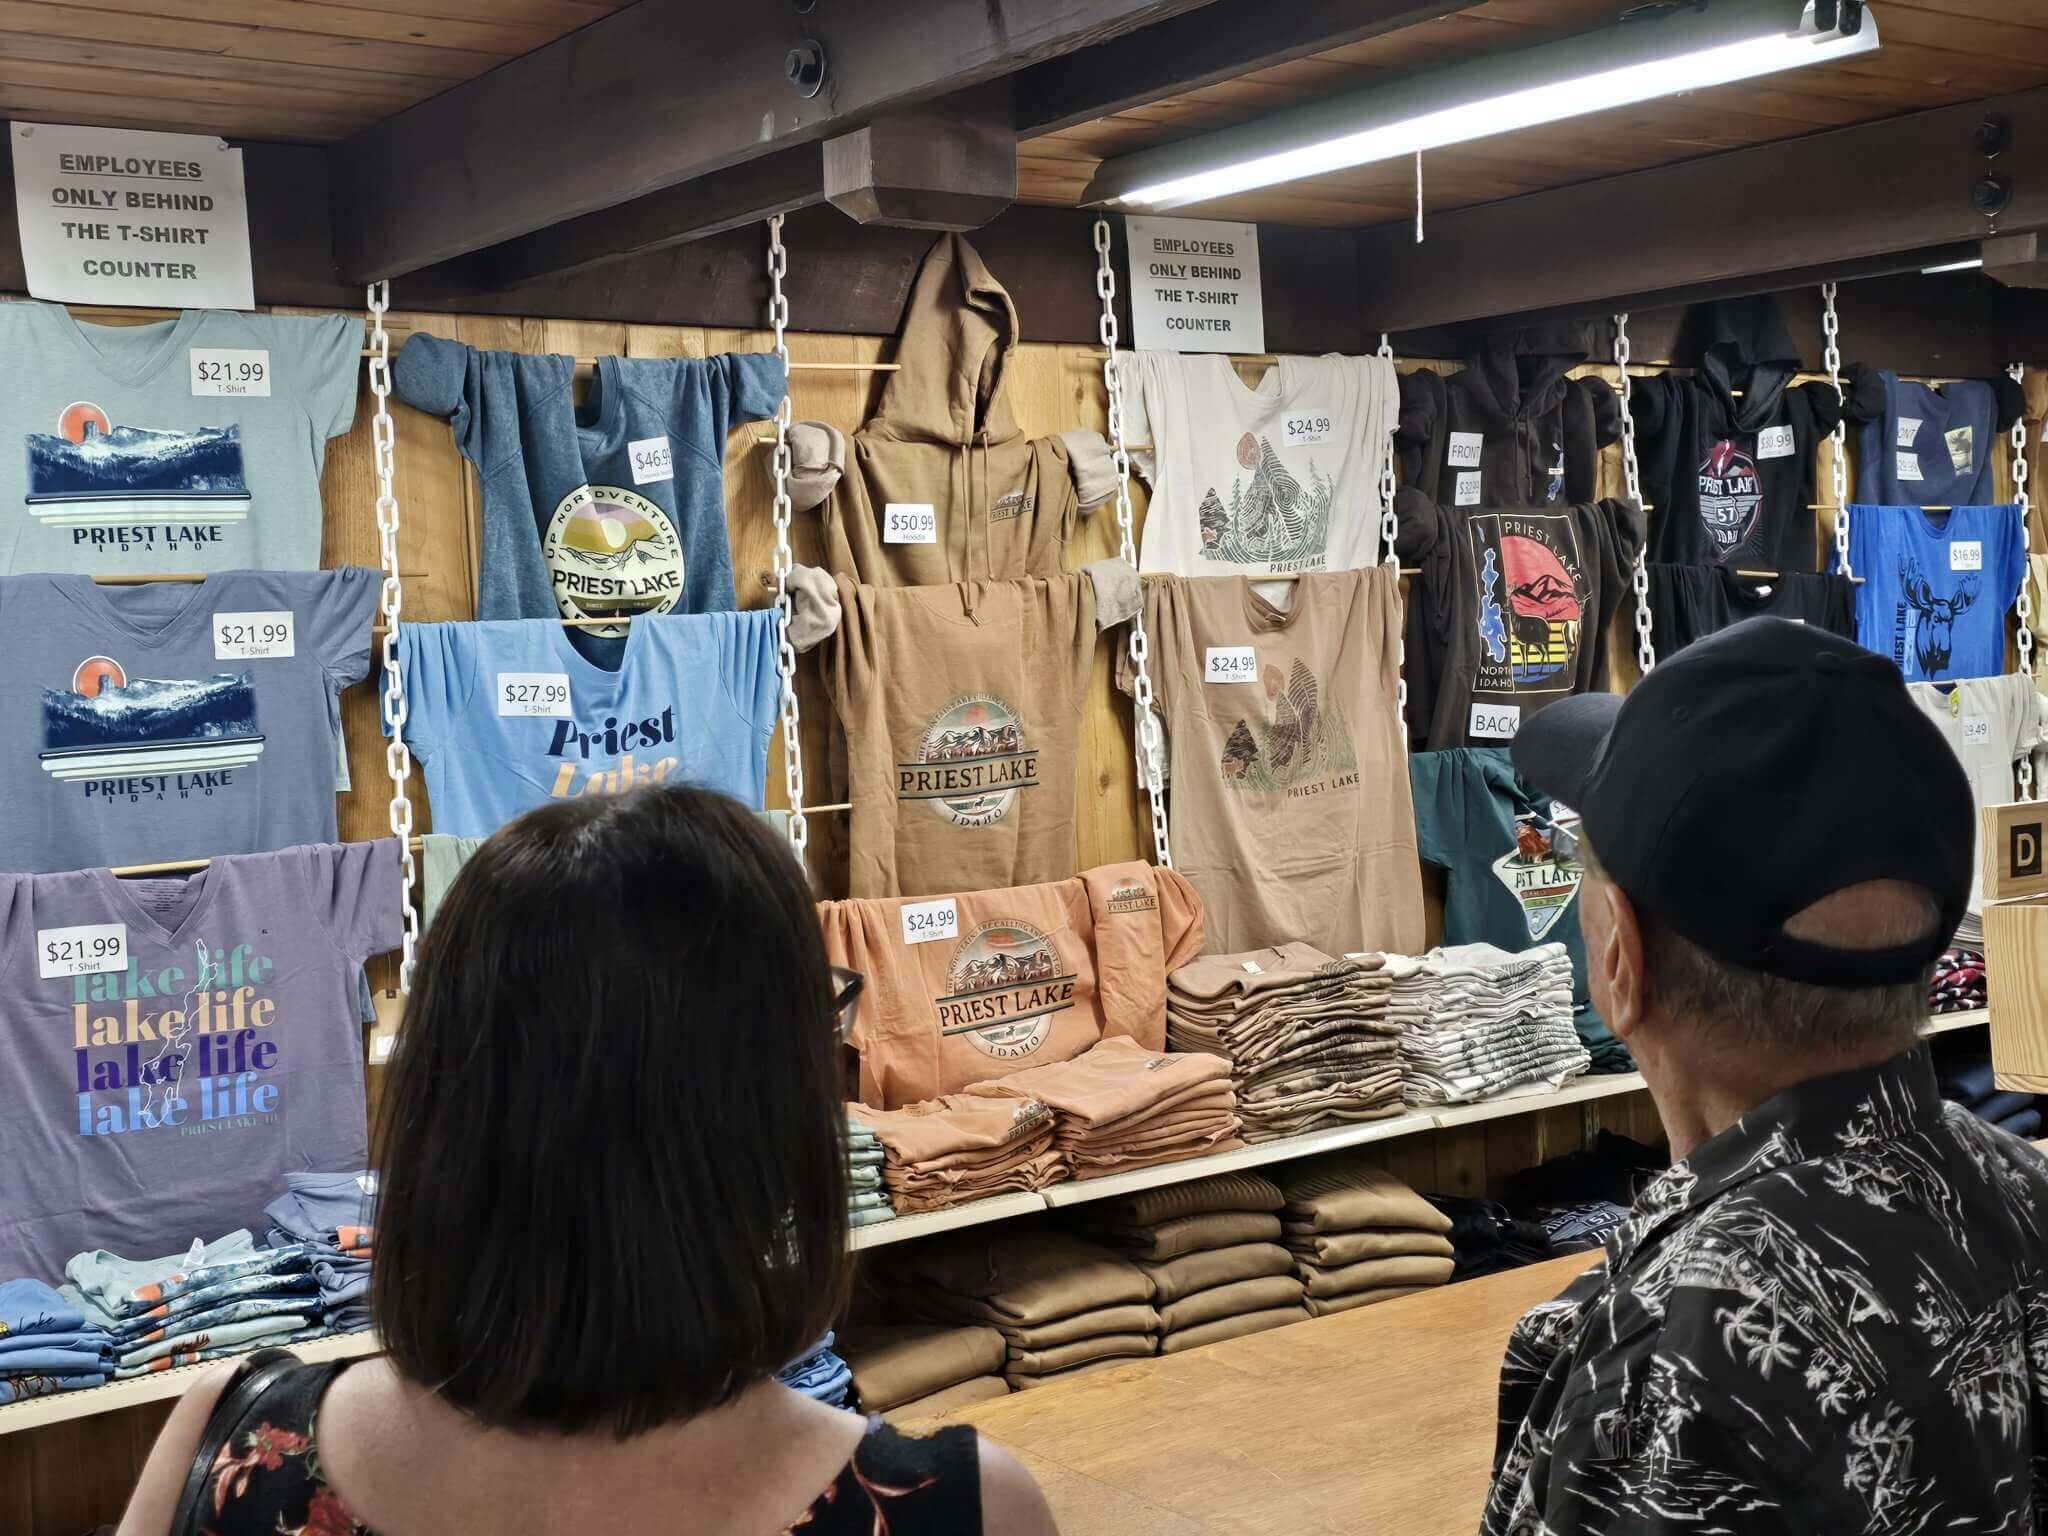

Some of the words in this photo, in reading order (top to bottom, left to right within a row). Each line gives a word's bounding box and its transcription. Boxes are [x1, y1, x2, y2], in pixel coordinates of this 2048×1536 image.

[60, 153, 202, 178] EMPLOYEES
[52, 188, 118, 207] ONLY
[126, 191, 215, 212] BEHIND
[61, 223, 110, 240] THE
[117, 225, 209, 244] T-SHIRT
[1153, 238, 1235, 255] EMPLOYEES
[83, 260, 198, 279] COUNTER
[1150, 263, 1187, 277] ONLY
[1191, 266, 1242, 280] BEHIND
[1154, 289, 1182, 302] THE
[1186, 290, 1239, 305] T-SHIRT
[1166, 317, 1231, 331] COUNTER
[198, 362, 264, 381] $21.99
[217, 384, 246, 394] T-Shirt
[1288, 418, 1331, 435] $24.99
[1452, 445, 1480, 459] FRONT
[891, 514, 934, 531] $50.99
[1717, 507, 1735, 522] 57
[74, 526, 157, 545] PRIEST
[166, 525, 223, 542] LAKE
[99, 542, 203, 553] IDAHO
[547, 533, 557, 559] UP
[1504, 521, 1550, 545] PRIEST
[1553, 545, 1582, 583] LAKE
[1952, 550, 1980, 561] $16.99
[1270, 560, 1302, 573] PRIEST
[553, 568, 626, 596] PRIEST
[629, 569, 681, 596] LAKE
[221, 624, 287, 645] $21.99
[240, 646, 270, 656] T-Shirt
[1212, 656, 1255, 672] $24.99
[1479, 679, 1513, 688] IDAHO
[506, 684, 567, 704] $27.99
[524, 705, 552, 714] T-Shirt
[544, 704, 677, 760] Priest
[1475, 715, 1517, 733] BACK
[85, 774, 169, 797] PRIEST
[177, 769, 234, 791] LAKE
[900, 767, 985, 792] PRIEST
[989, 758, 1037, 784] LAKE
[1287, 782, 1326, 799] PRIEST
[1332, 772, 1360, 789] LAKE
[107, 787, 214, 804] IDAHO
[951, 808, 1002, 827] IDAHO
[2016, 832, 2036, 867] D
[1135, 898, 1156, 909] LAKE
[907, 910, 955, 932] $24.99
[47, 937, 121, 963] $21.99
[68, 960, 101, 973] T-Shirt
[72, 955, 185, 1003] lake
[194, 944, 273, 989] life
[940, 995, 1009, 1027] PRIEST
[1015, 982, 1075, 1012] LAKE
[72, 999, 186, 1049] lake
[196, 986, 276, 1036] life
[990, 1035, 1040, 1057] IDAHO
[74, 1043, 188, 1093] lake
[198, 1028, 279, 1080] life
[75, 1086, 189, 1136] lake
[198, 1071, 279, 1121] life
